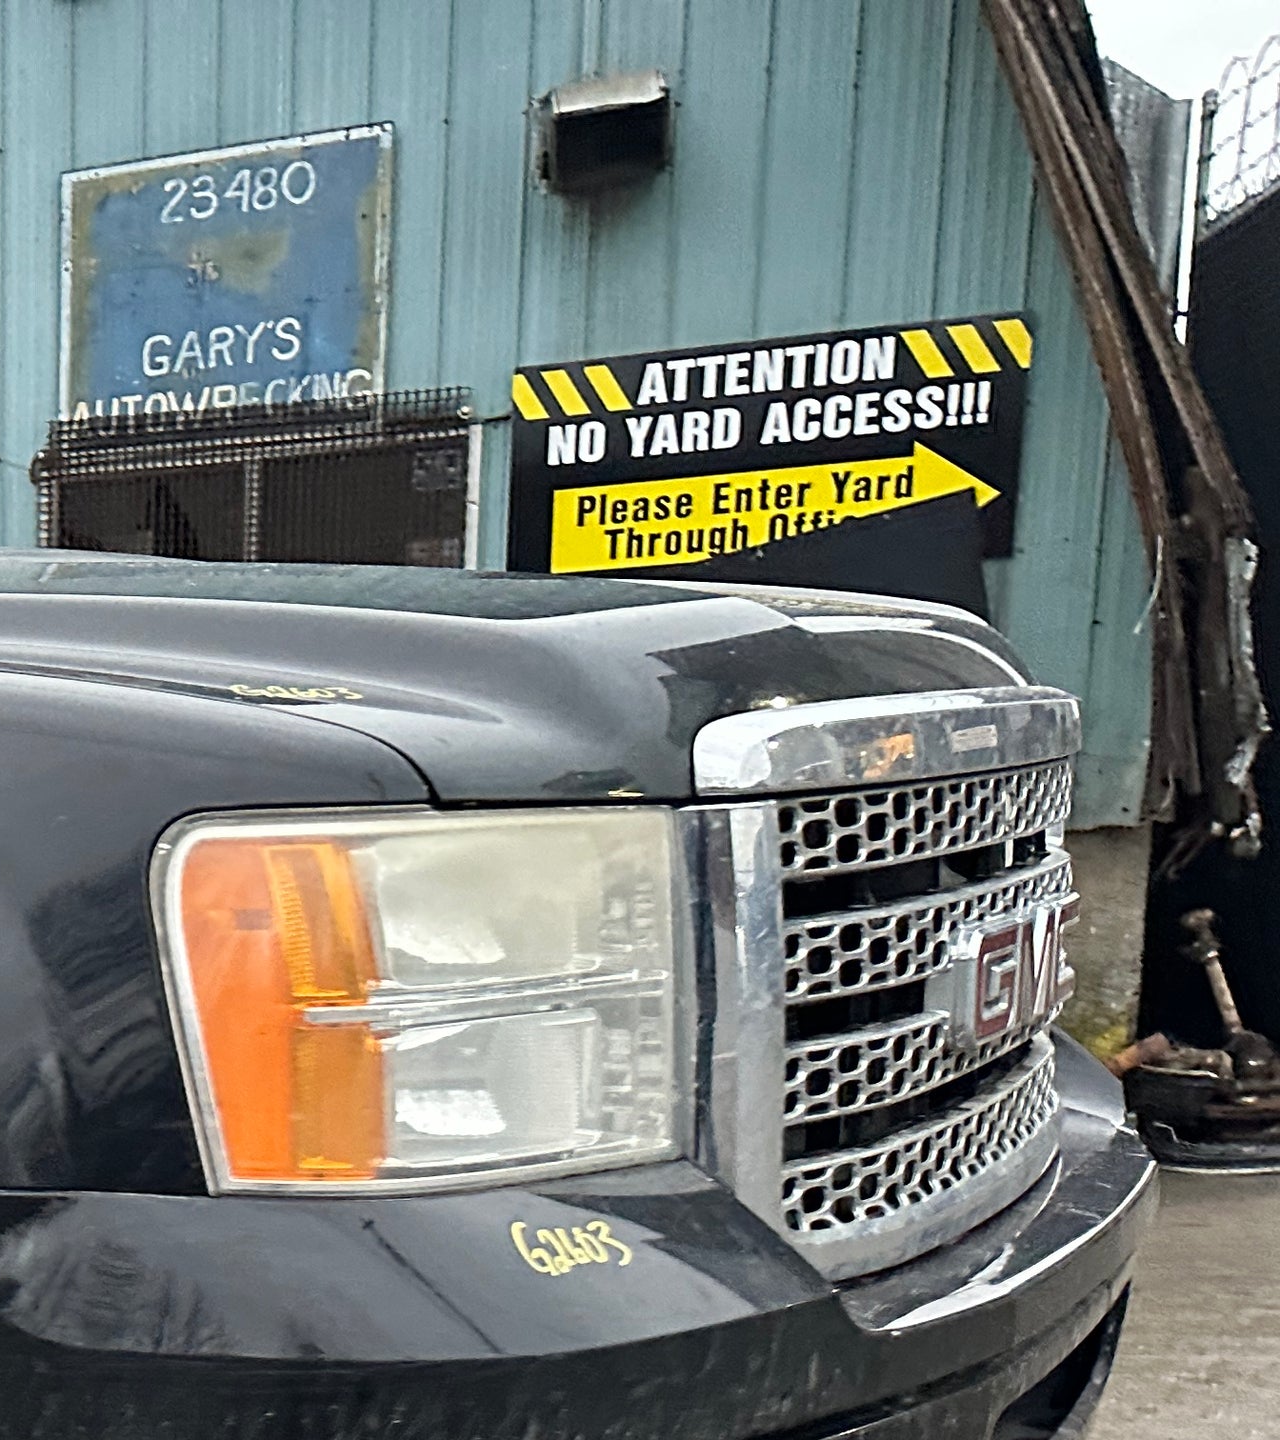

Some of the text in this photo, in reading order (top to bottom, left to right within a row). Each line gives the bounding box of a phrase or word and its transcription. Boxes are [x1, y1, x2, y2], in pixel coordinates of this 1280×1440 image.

[160, 160, 316, 223] 23480
[142, 316, 302, 377] GARY'S
[637, 335, 897, 406] ATTENTION
[546, 380, 993, 467] NO YARD ACCESS!!!
[576, 465, 914, 527] Please Enter Yard
[604, 511, 860, 561] Through Offi
